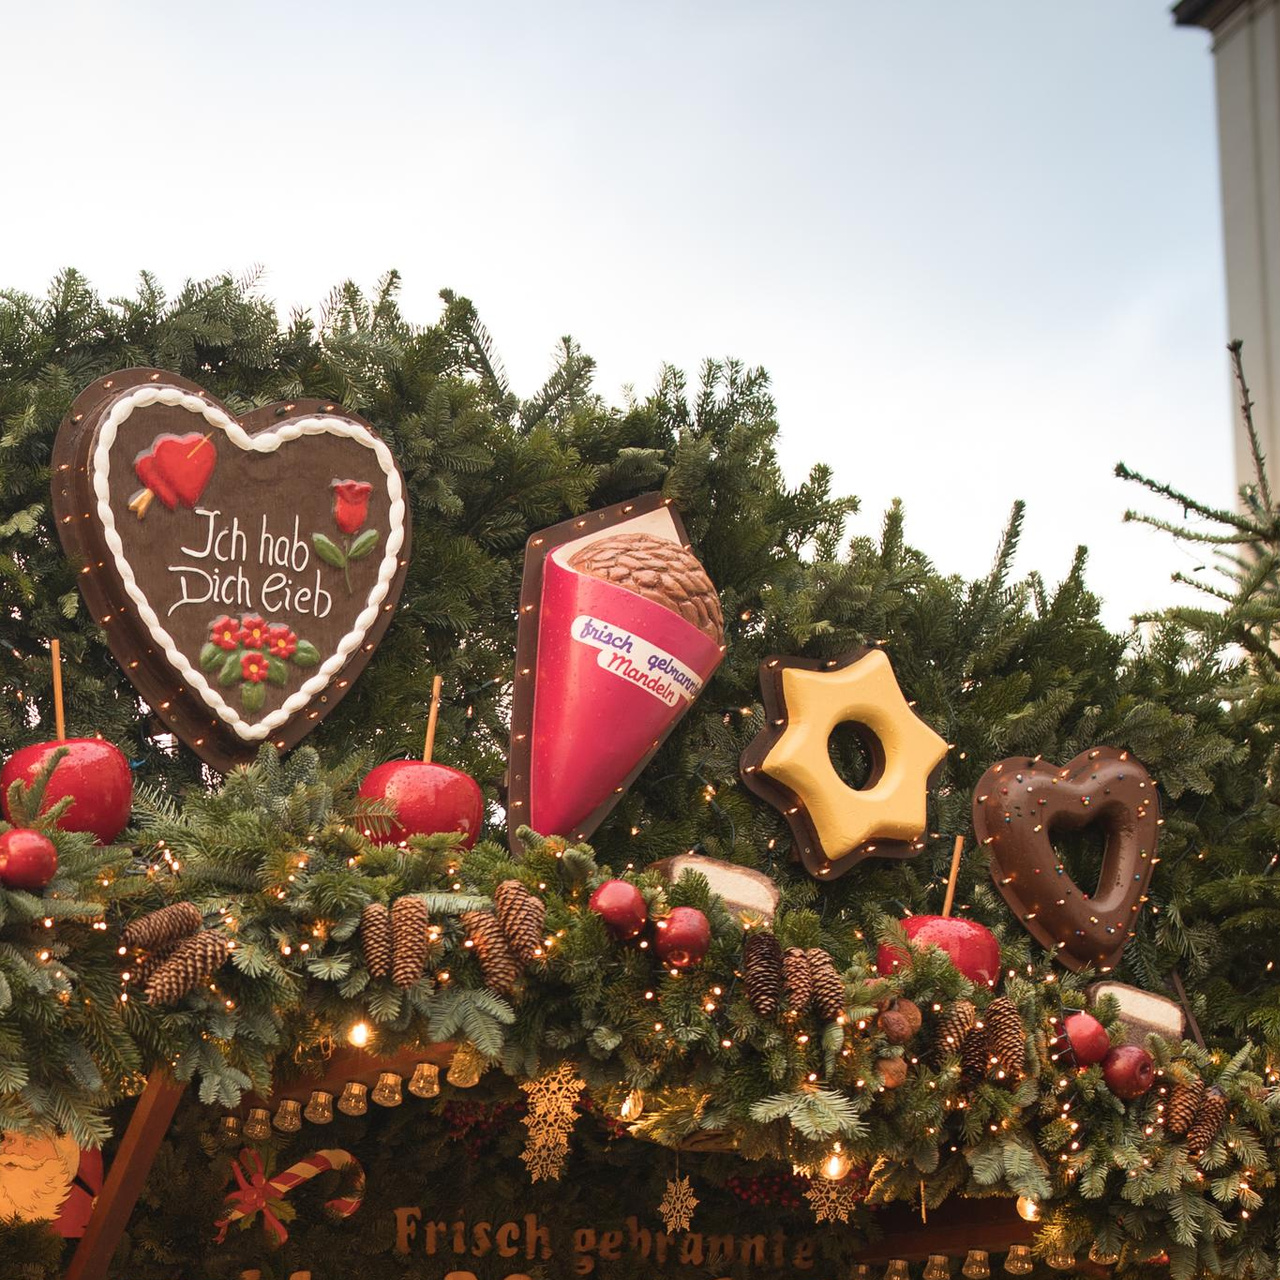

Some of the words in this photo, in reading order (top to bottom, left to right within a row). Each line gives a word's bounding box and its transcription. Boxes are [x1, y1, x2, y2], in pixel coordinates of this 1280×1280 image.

[259, 514, 310, 572] hab
[167, 565, 252, 617] Dich
[580, 618, 634, 654] frisch
[607, 651, 676, 703] Mandeln
[394, 1206, 552, 1259] Frisch
[573, 1216, 818, 1276] gebrannte
